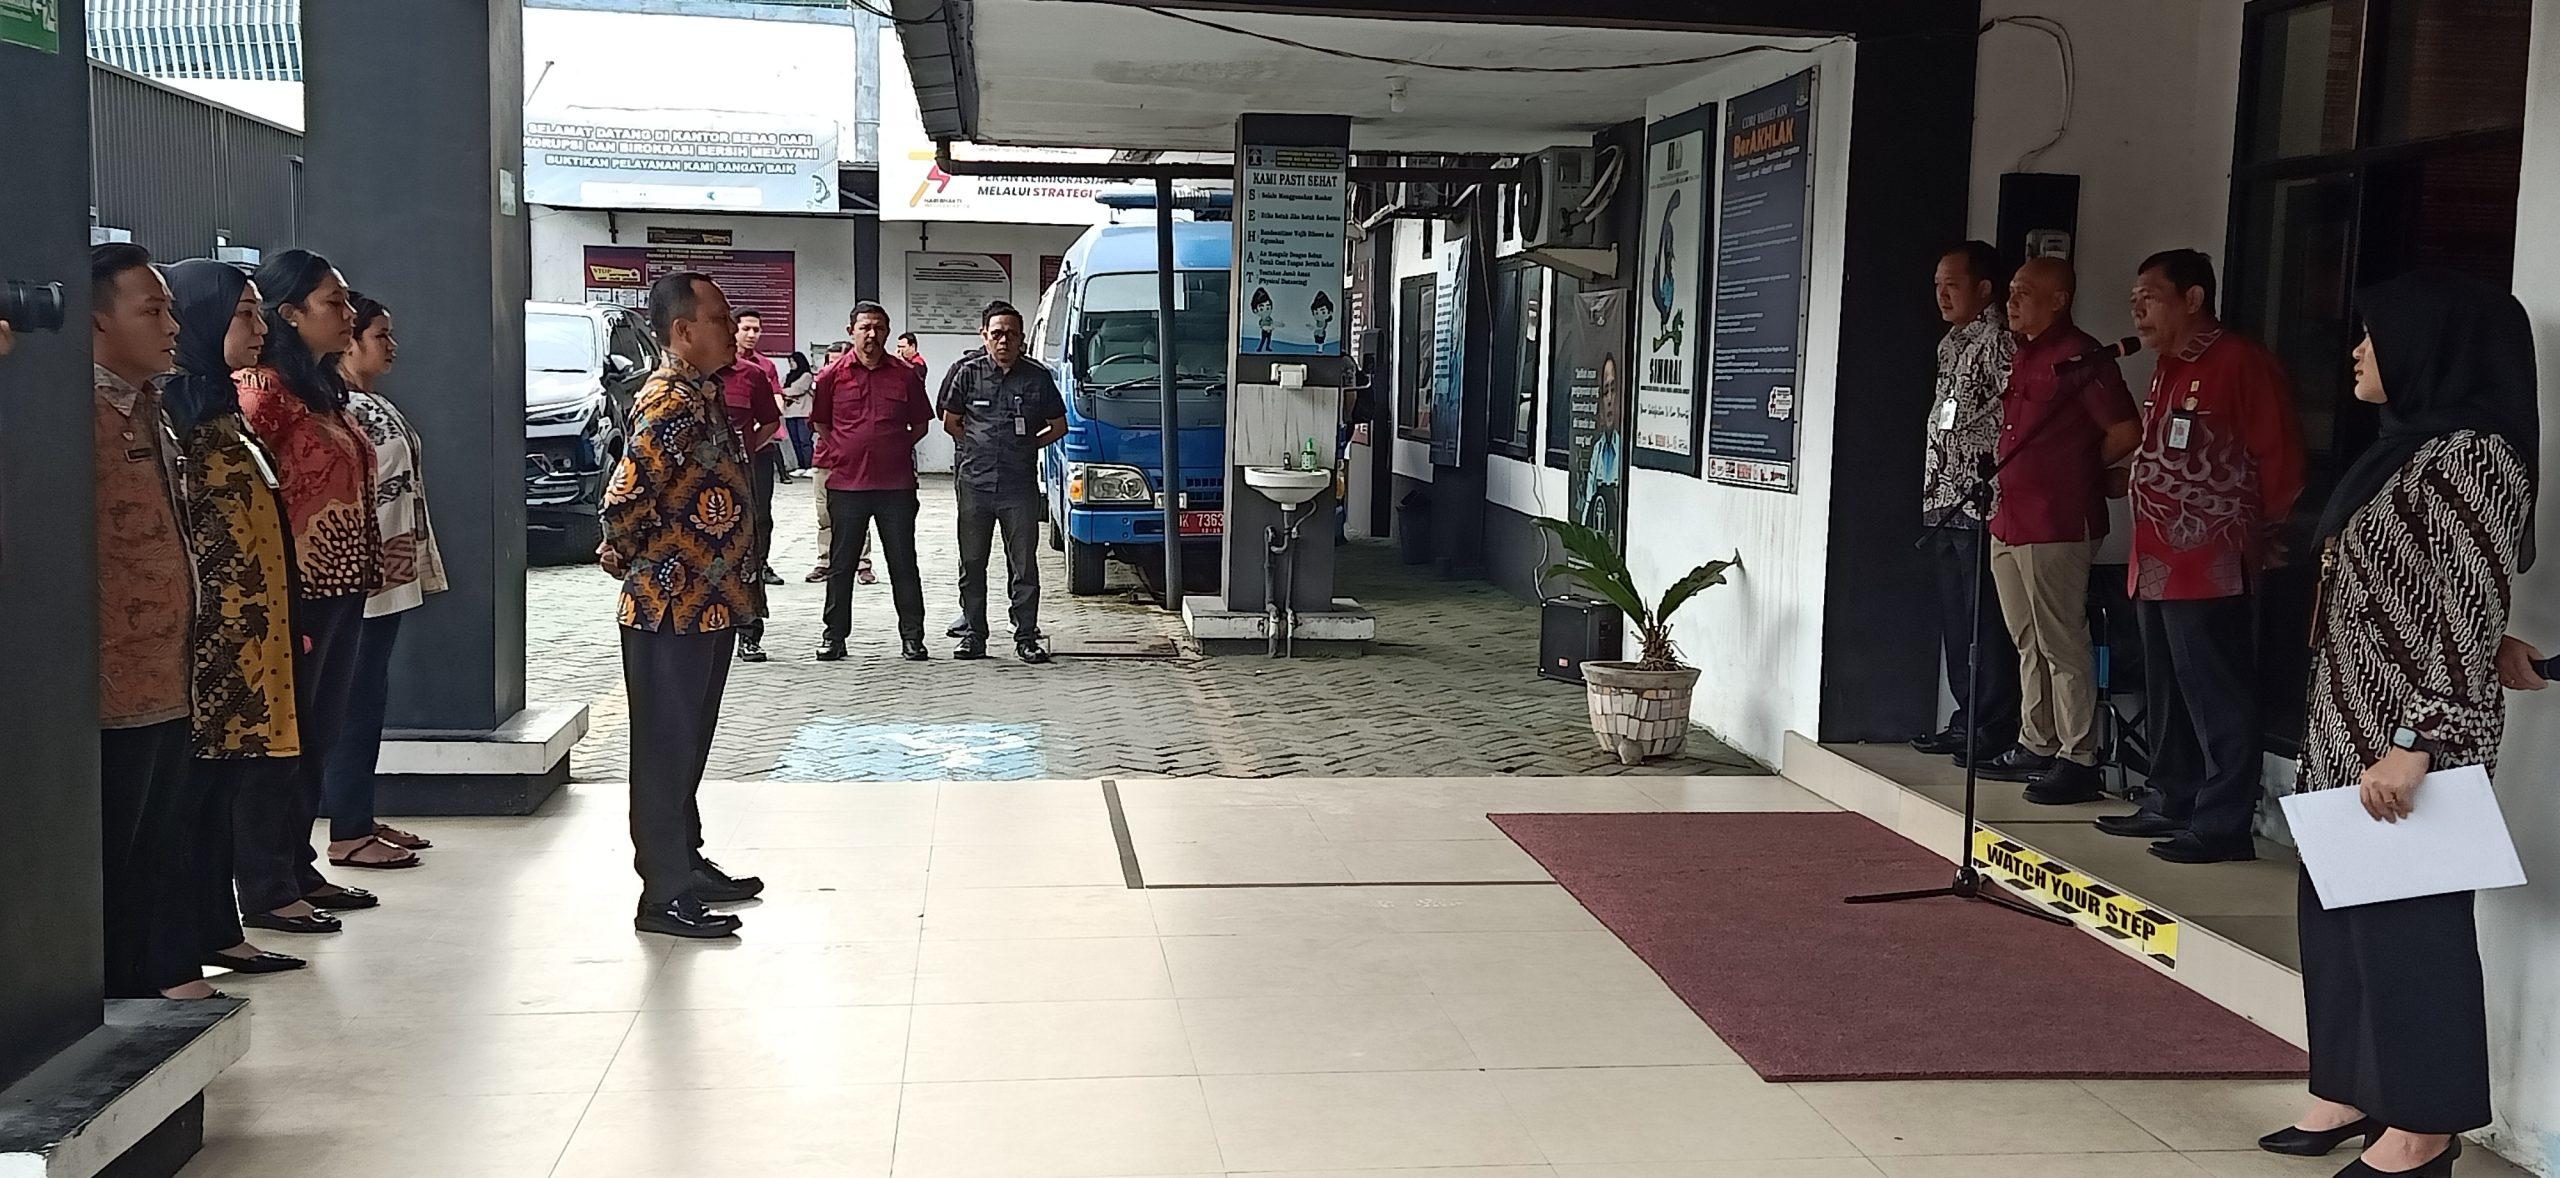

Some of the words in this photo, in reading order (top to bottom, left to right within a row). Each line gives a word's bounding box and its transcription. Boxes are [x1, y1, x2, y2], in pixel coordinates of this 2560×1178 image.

[527, 122, 594, 138] SELAMAT
[596, 127, 652, 141] DATANG
[654, 130, 670, 141] DI
[672, 130, 730, 144] KANTOR
[732, 132, 778, 145] BEBAS
[779, 134, 813, 146] DARI
[1733, 117, 1794, 159] BerAKHLAK
[523, 136, 584, 151] KORUPSI
[586, 140, 617, 153] DAN
[618, 142, 696, 156] BIROKRASI
[697, 145, 749, 158] BERSIH
[750, 147, 820, 160] MELAYANI
[545, 154, 610, 169] BUKTIKAN
[611, 157, 681, 171] PELAYANAN
[683, 160, 715, 173] KAMI
[716, 162, 765, 174] SANGAT
[765, 162, 796, 175] BAIK
[1253, 172, 1277, 185] KAMI
[1279, 173, 1306, 187] PASTI
[1307, 175, 1338, 187] SEHAT
[977, 186, 1031, 197] MELALUI
[1033, 188, 1092, 198] STRATEGI
[1249, 189, 1256, 200] S
[1248, 210, 1256, 221] E
[1248, 230, 1256, 242] H
[1246, 251, 1254, 263] A
[1246, 271, 1254, 282] T
[1196, 513, 1224, 528] 7363
[1986, 843, 2047, 889] WATCH
[2050, 874, 2100, 916] YOUR
[2105, 903, 2156, 941] STEP
